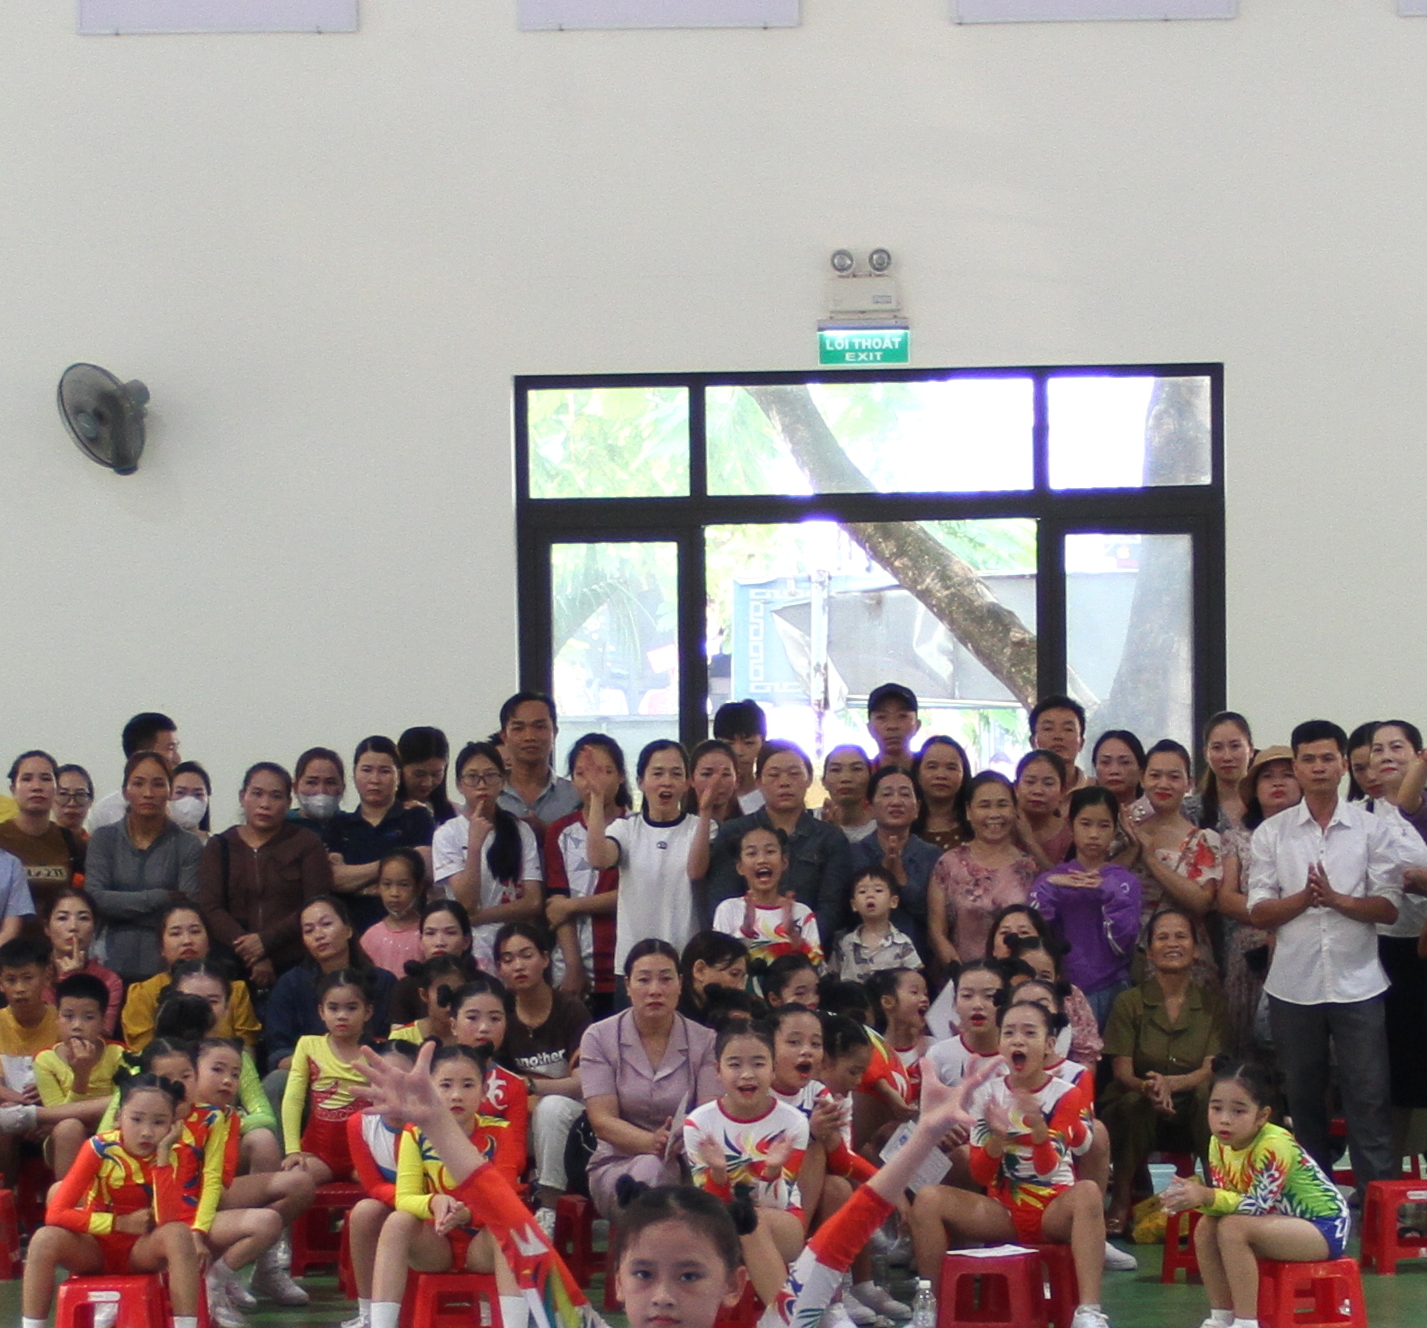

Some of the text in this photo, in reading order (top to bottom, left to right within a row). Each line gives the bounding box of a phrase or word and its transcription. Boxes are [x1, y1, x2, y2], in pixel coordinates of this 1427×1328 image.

[851, 335, 902, 350] THOÁT
[844, 351, 883, 361] EXIT
[514, 1049, 566, 1067] another
